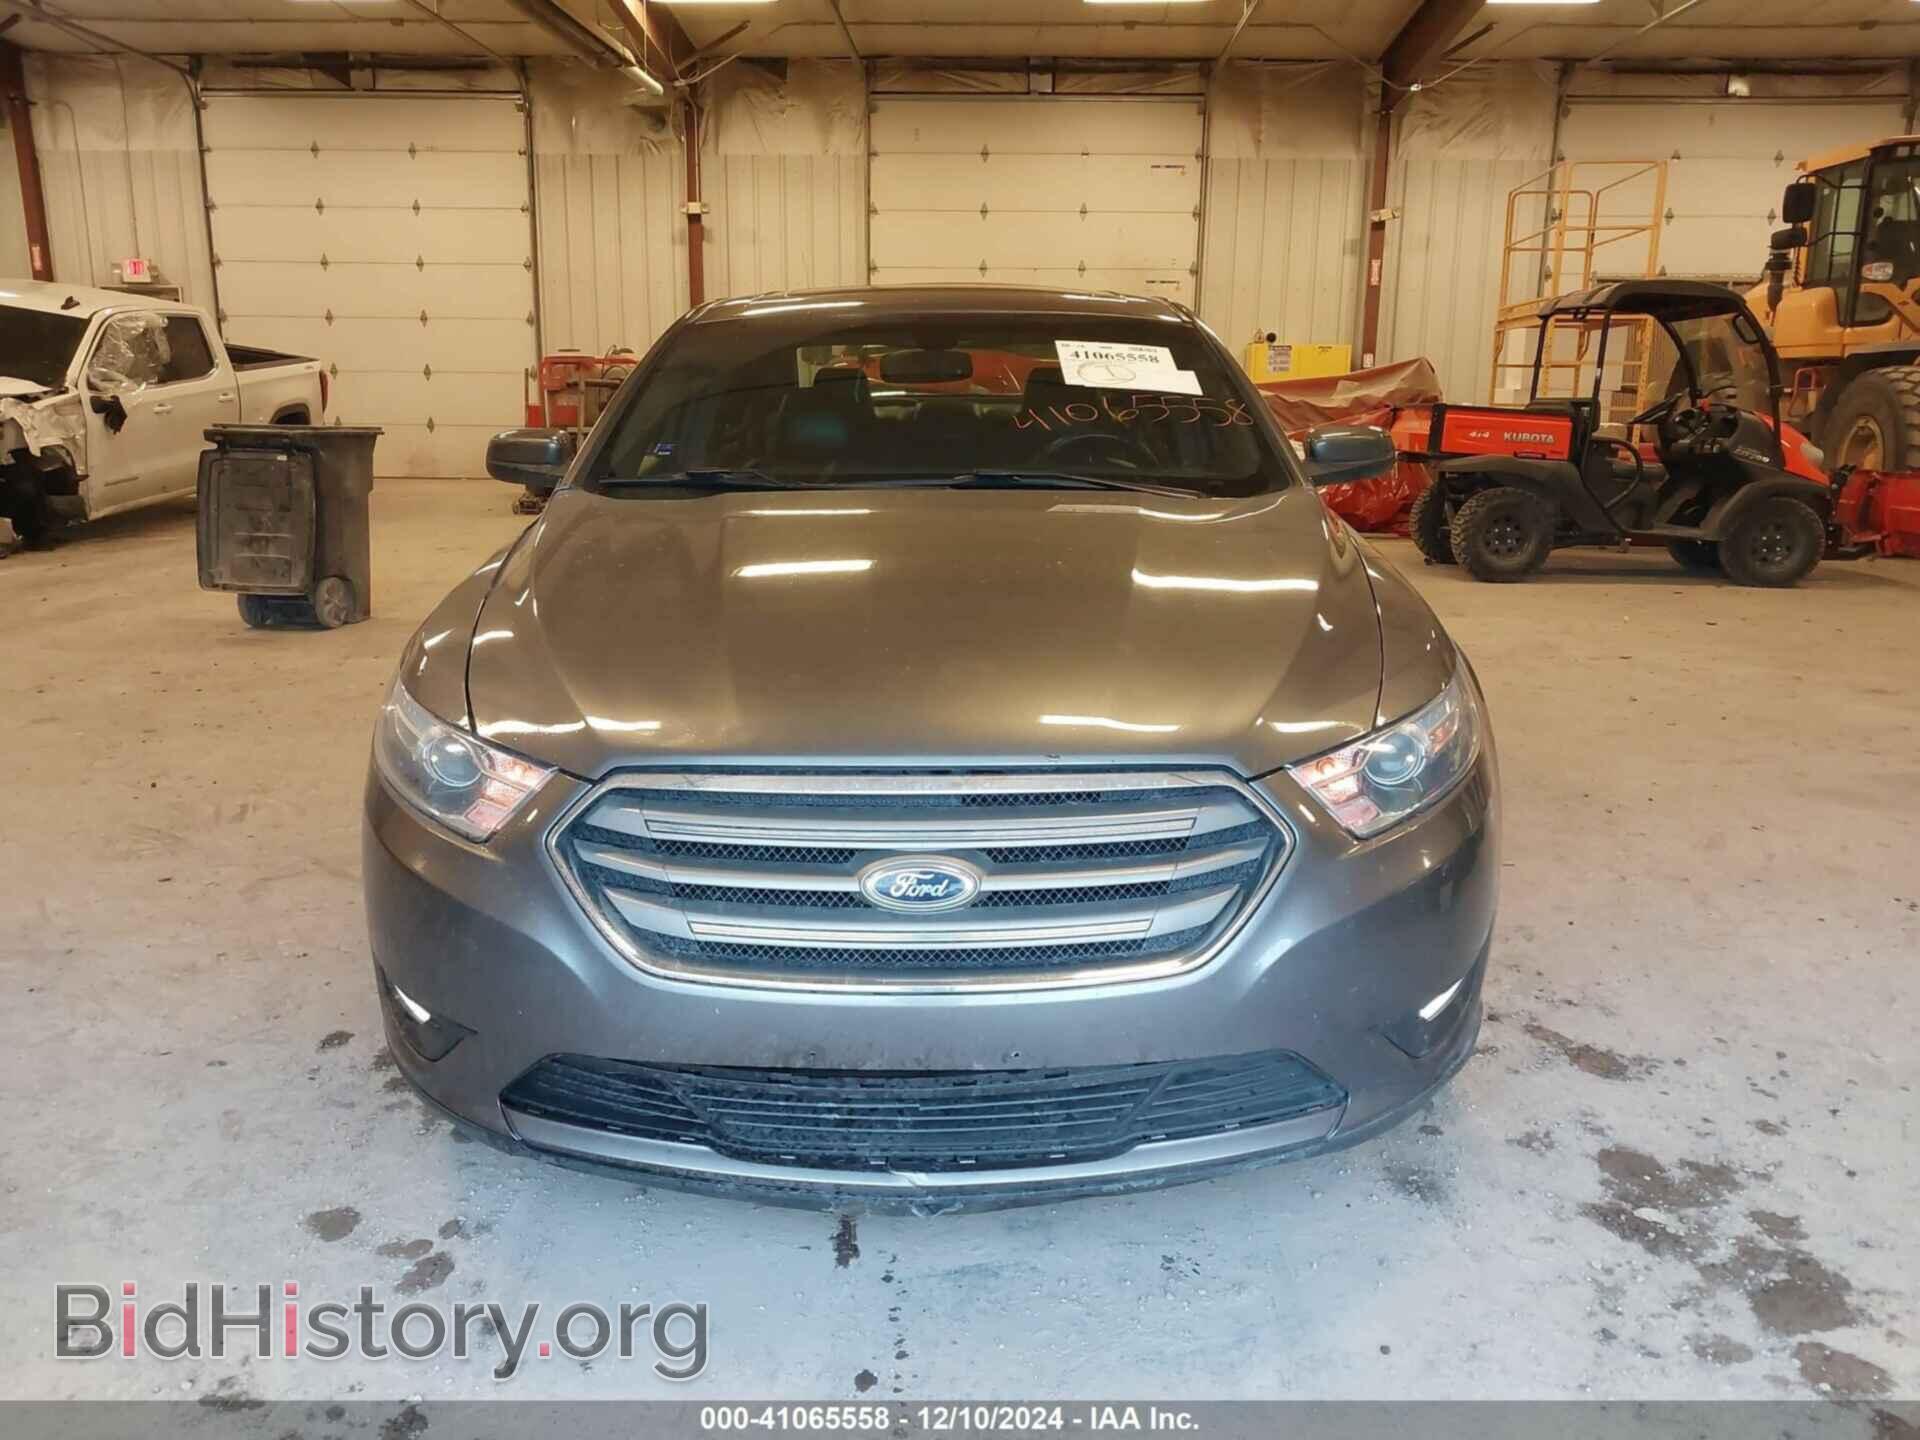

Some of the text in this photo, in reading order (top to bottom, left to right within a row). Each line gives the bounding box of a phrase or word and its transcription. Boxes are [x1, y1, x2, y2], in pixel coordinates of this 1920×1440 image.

[1070, 350, 1160, 364] 41065558
[1503, 431, 1554, 444] KUBOTA
[890, 872, 950, 897] Ford
